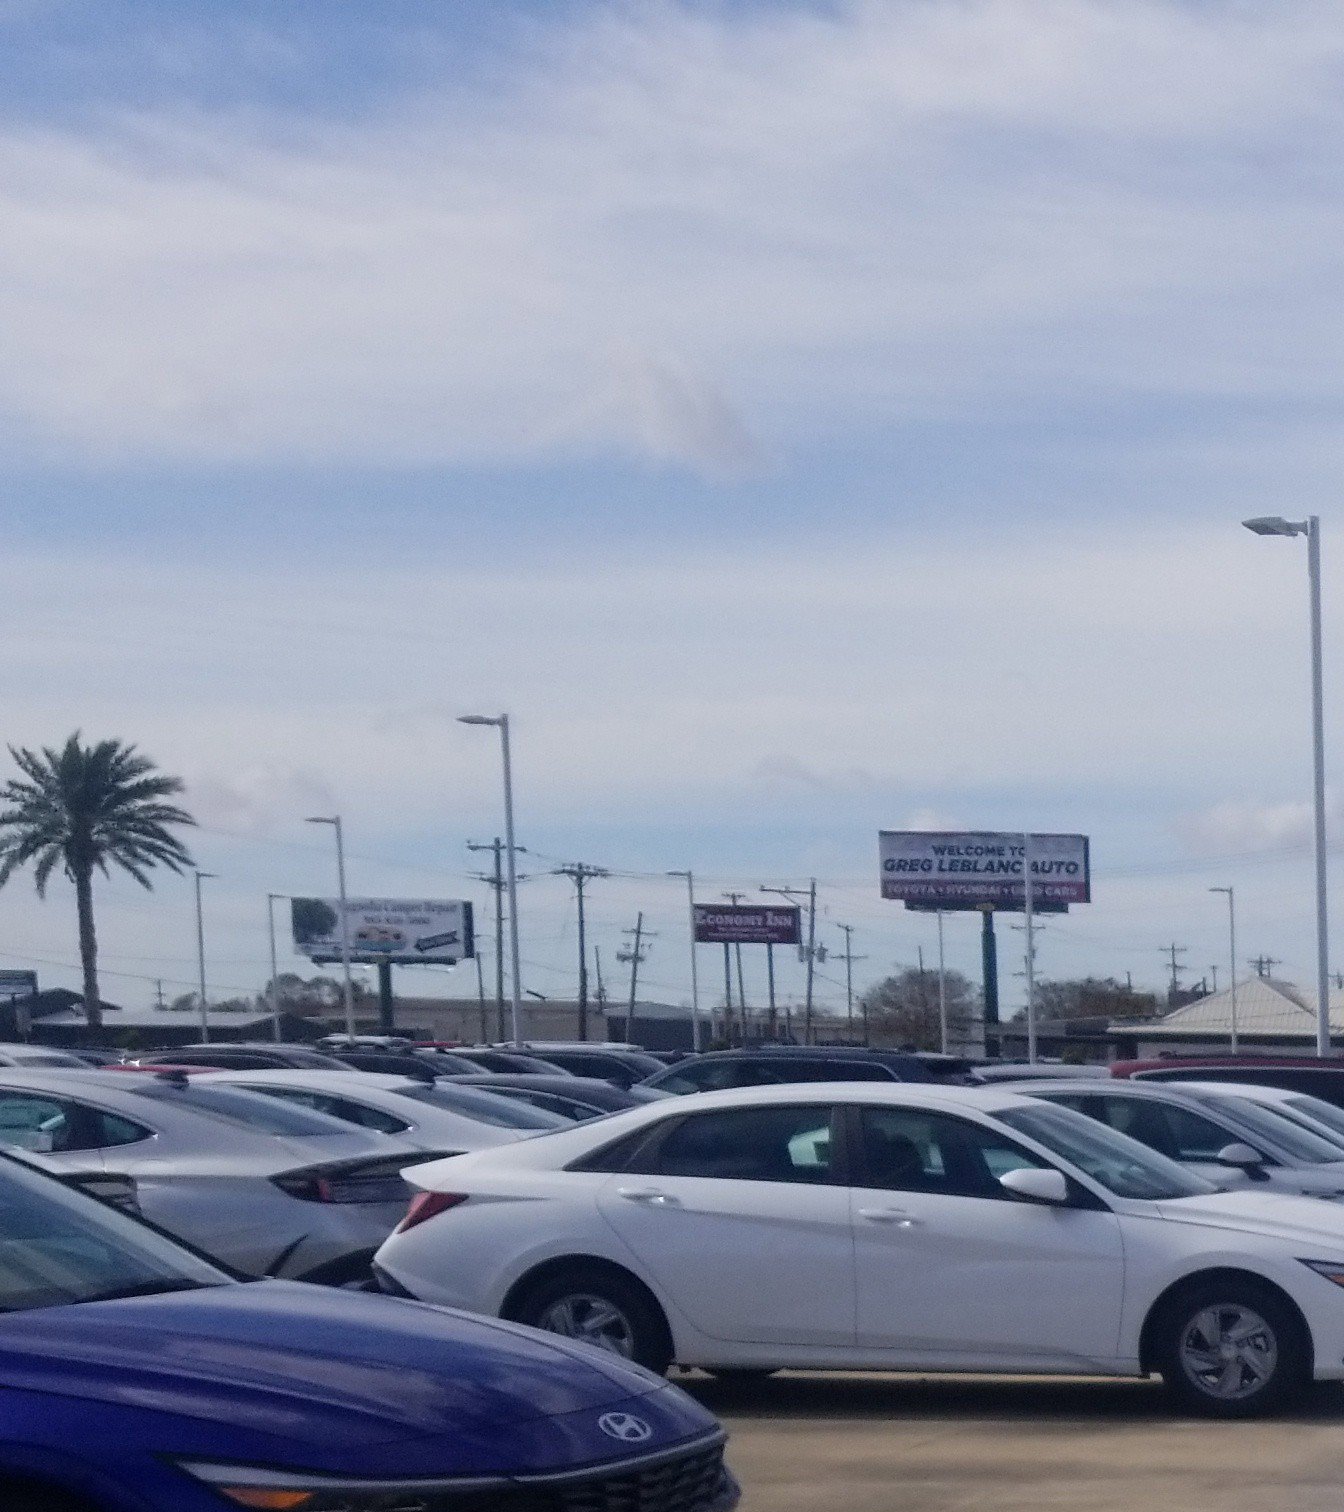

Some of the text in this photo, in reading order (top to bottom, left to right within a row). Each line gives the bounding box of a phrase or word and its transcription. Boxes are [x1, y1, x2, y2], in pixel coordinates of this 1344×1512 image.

[932, 845, 1005, 857] WELCOME
[883, 858, 1079, 875] GREG LEBLANC AUTO
